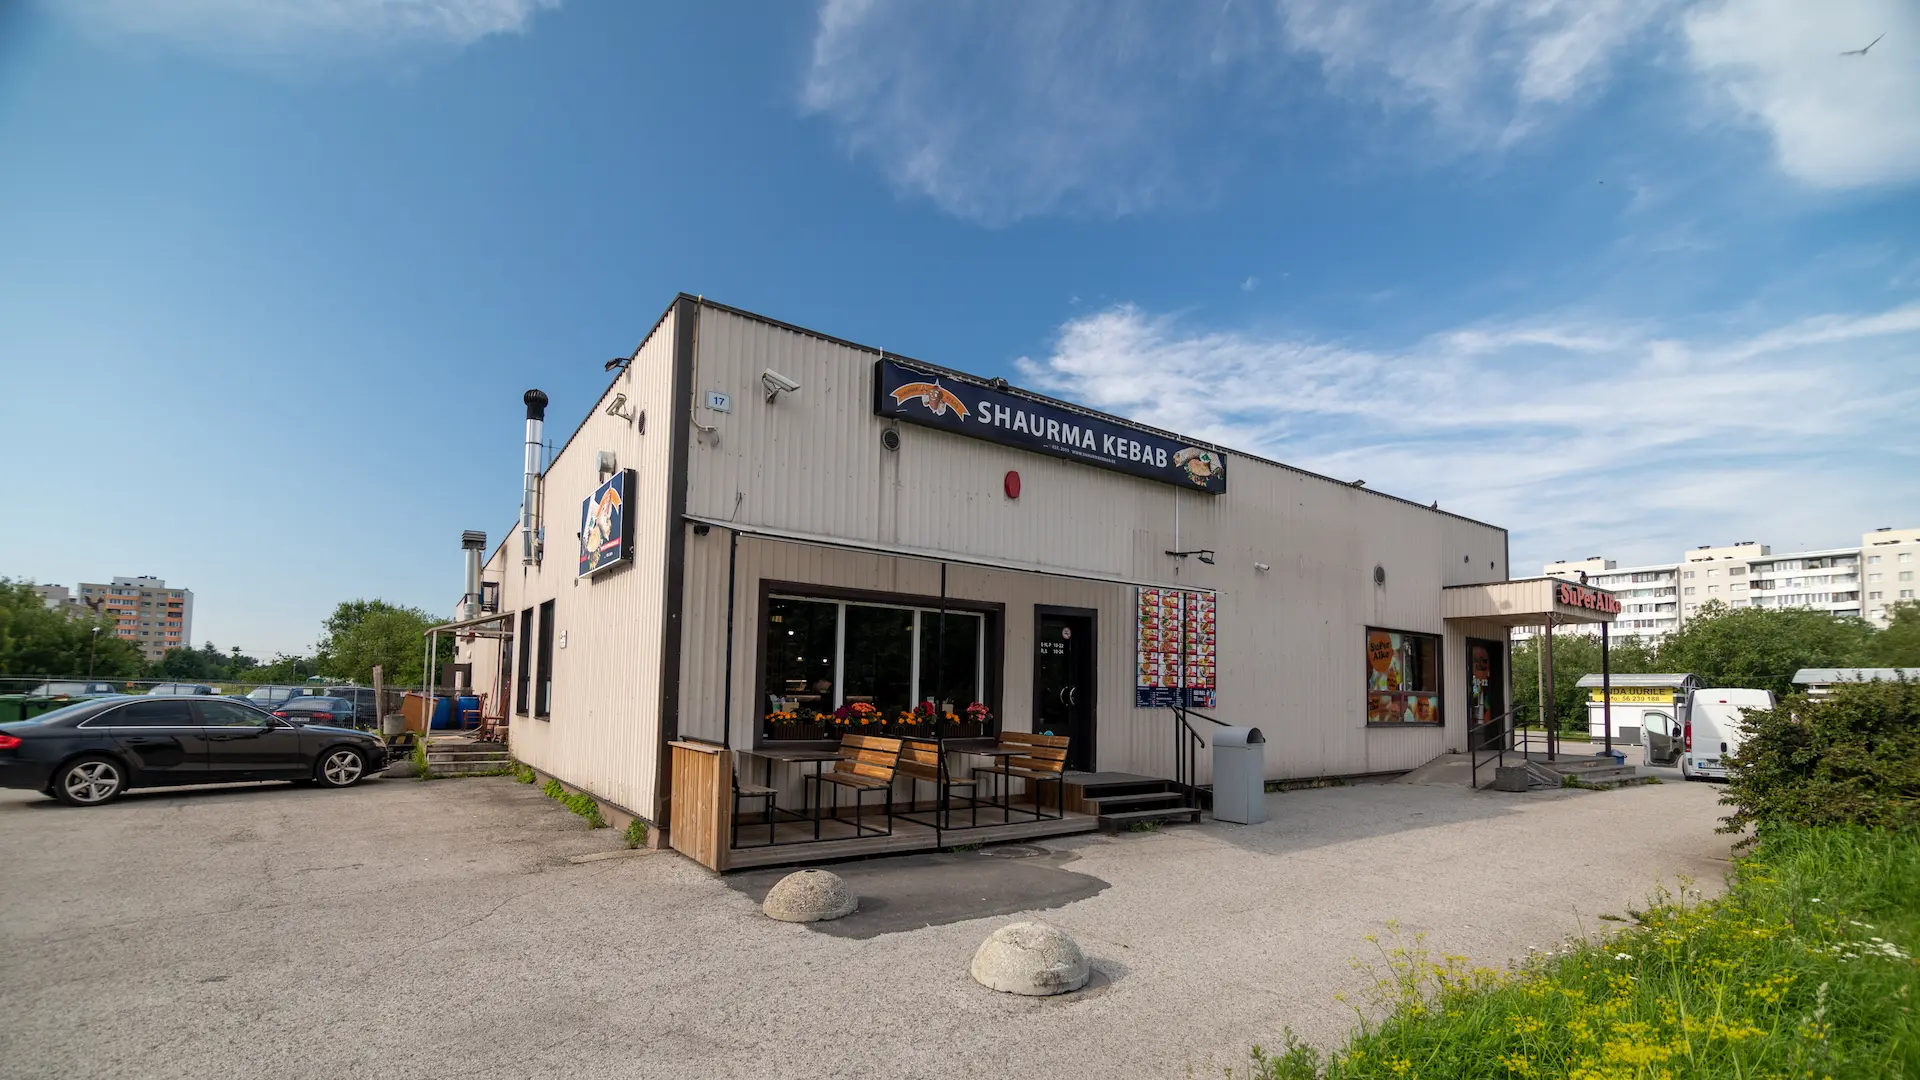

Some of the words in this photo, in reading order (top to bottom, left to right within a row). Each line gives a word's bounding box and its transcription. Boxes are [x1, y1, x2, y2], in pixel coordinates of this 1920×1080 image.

[714, 396, 725, 405] 17
[978, 401, 1097, 451] SHAURMA
[1103, 433, 1168, 468] KEBAB
